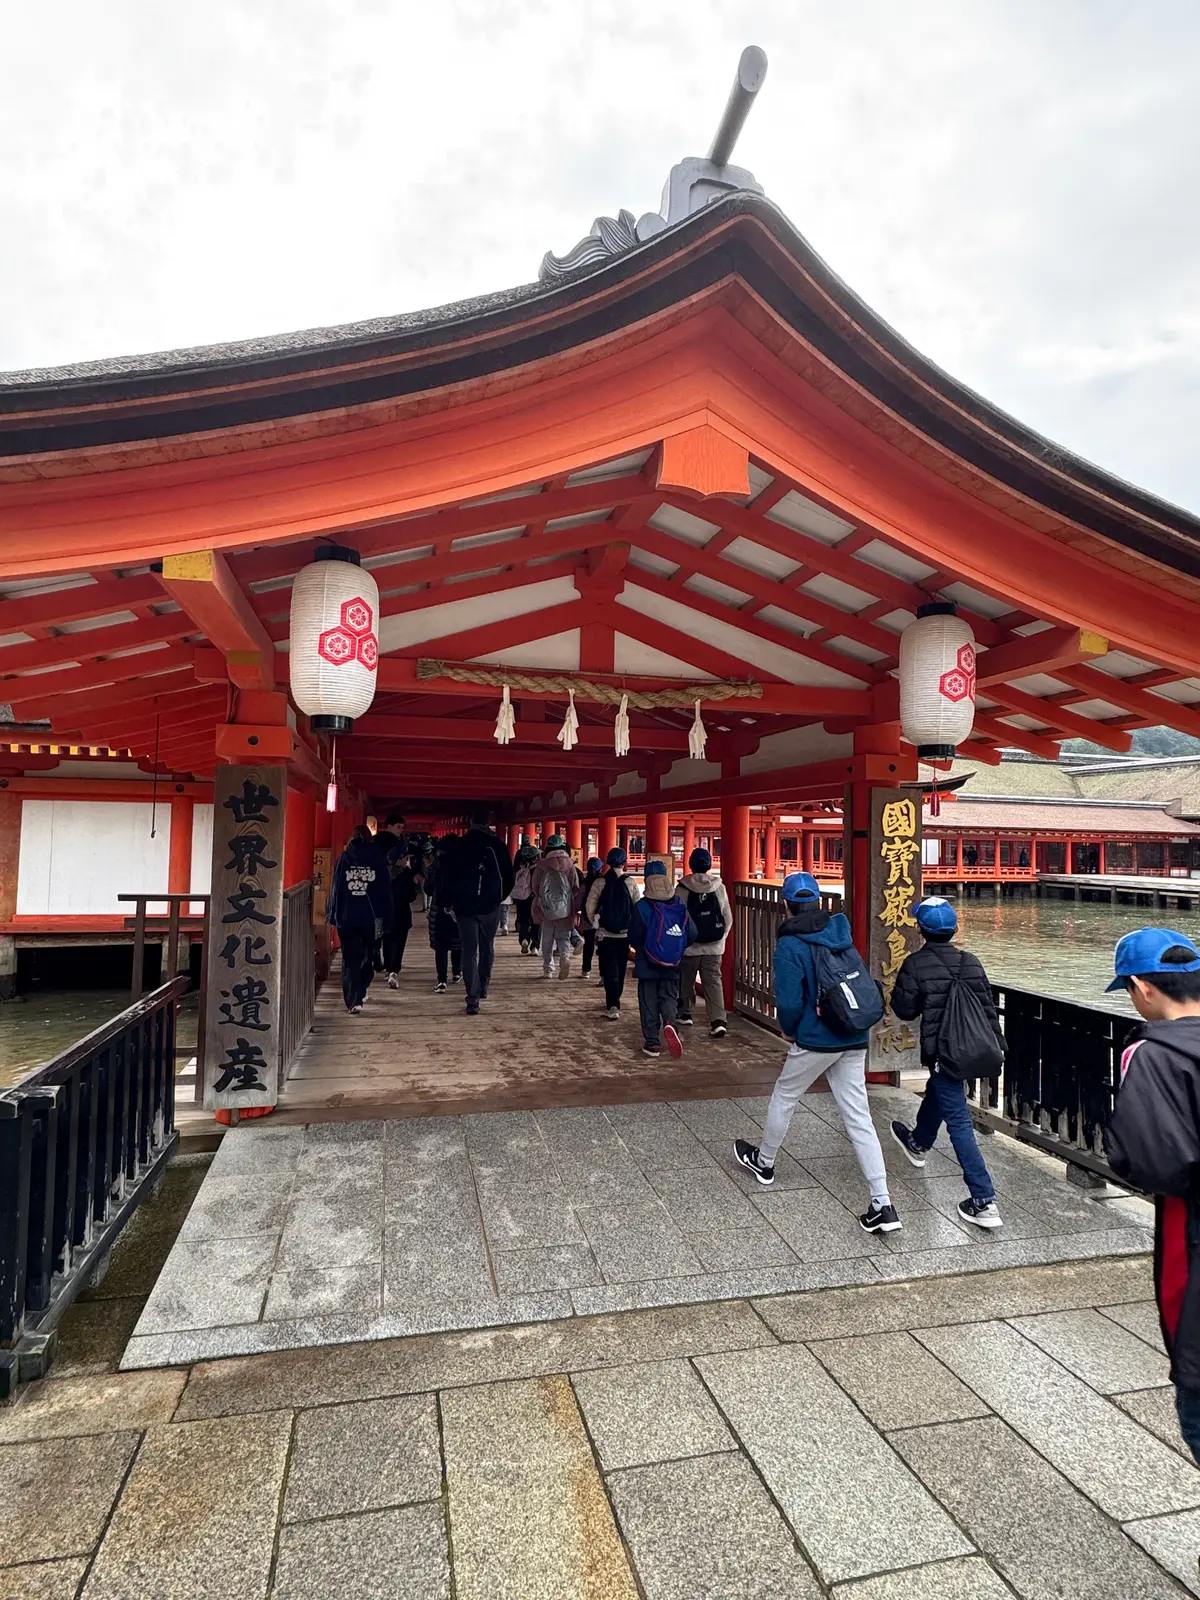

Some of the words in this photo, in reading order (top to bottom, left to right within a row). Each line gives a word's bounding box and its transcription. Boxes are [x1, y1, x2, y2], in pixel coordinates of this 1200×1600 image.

[213, 779, 279, 1093] 世界文化遺産
